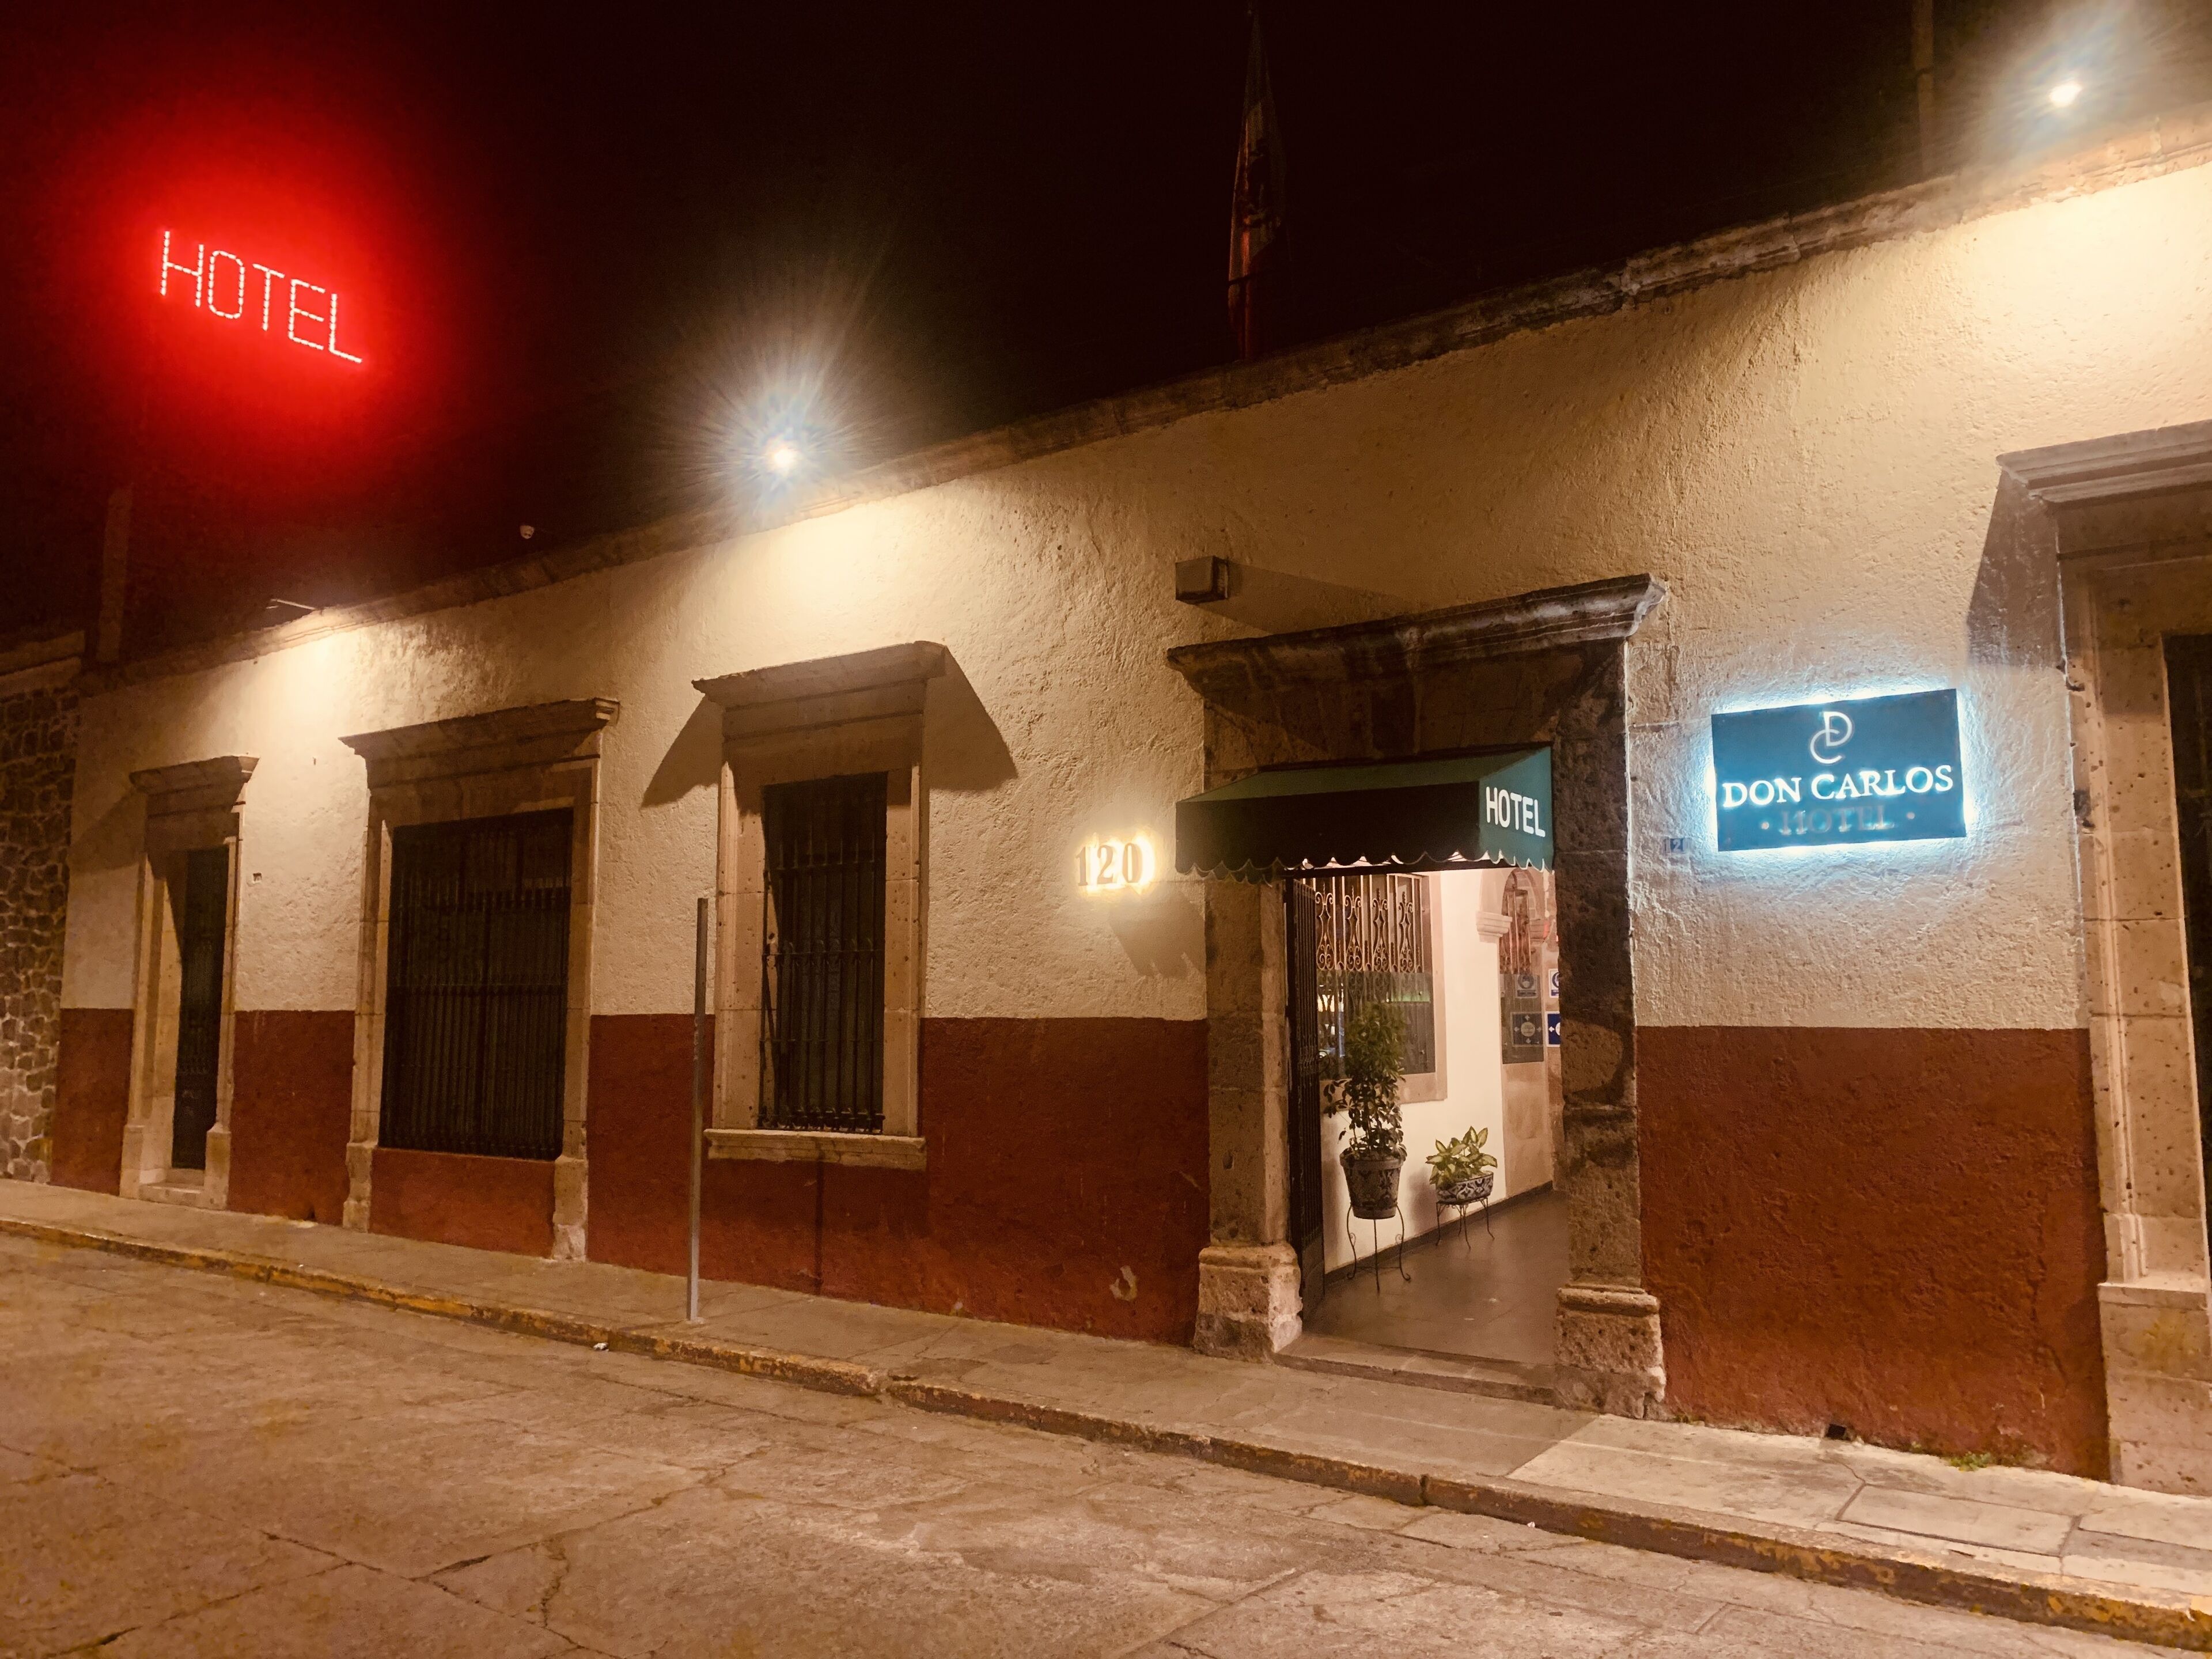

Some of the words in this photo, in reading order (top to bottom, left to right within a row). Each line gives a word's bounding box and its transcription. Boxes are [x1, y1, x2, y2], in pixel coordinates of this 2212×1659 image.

[161, 230, 363, 363] HOTEL
[1722, 777, 1802, 808] DON
[1810, 764, 1954, 800] CARLOS
[1486, 786, 1546, 838] HOTEL
[1075, 842, 1143, 887] 120
